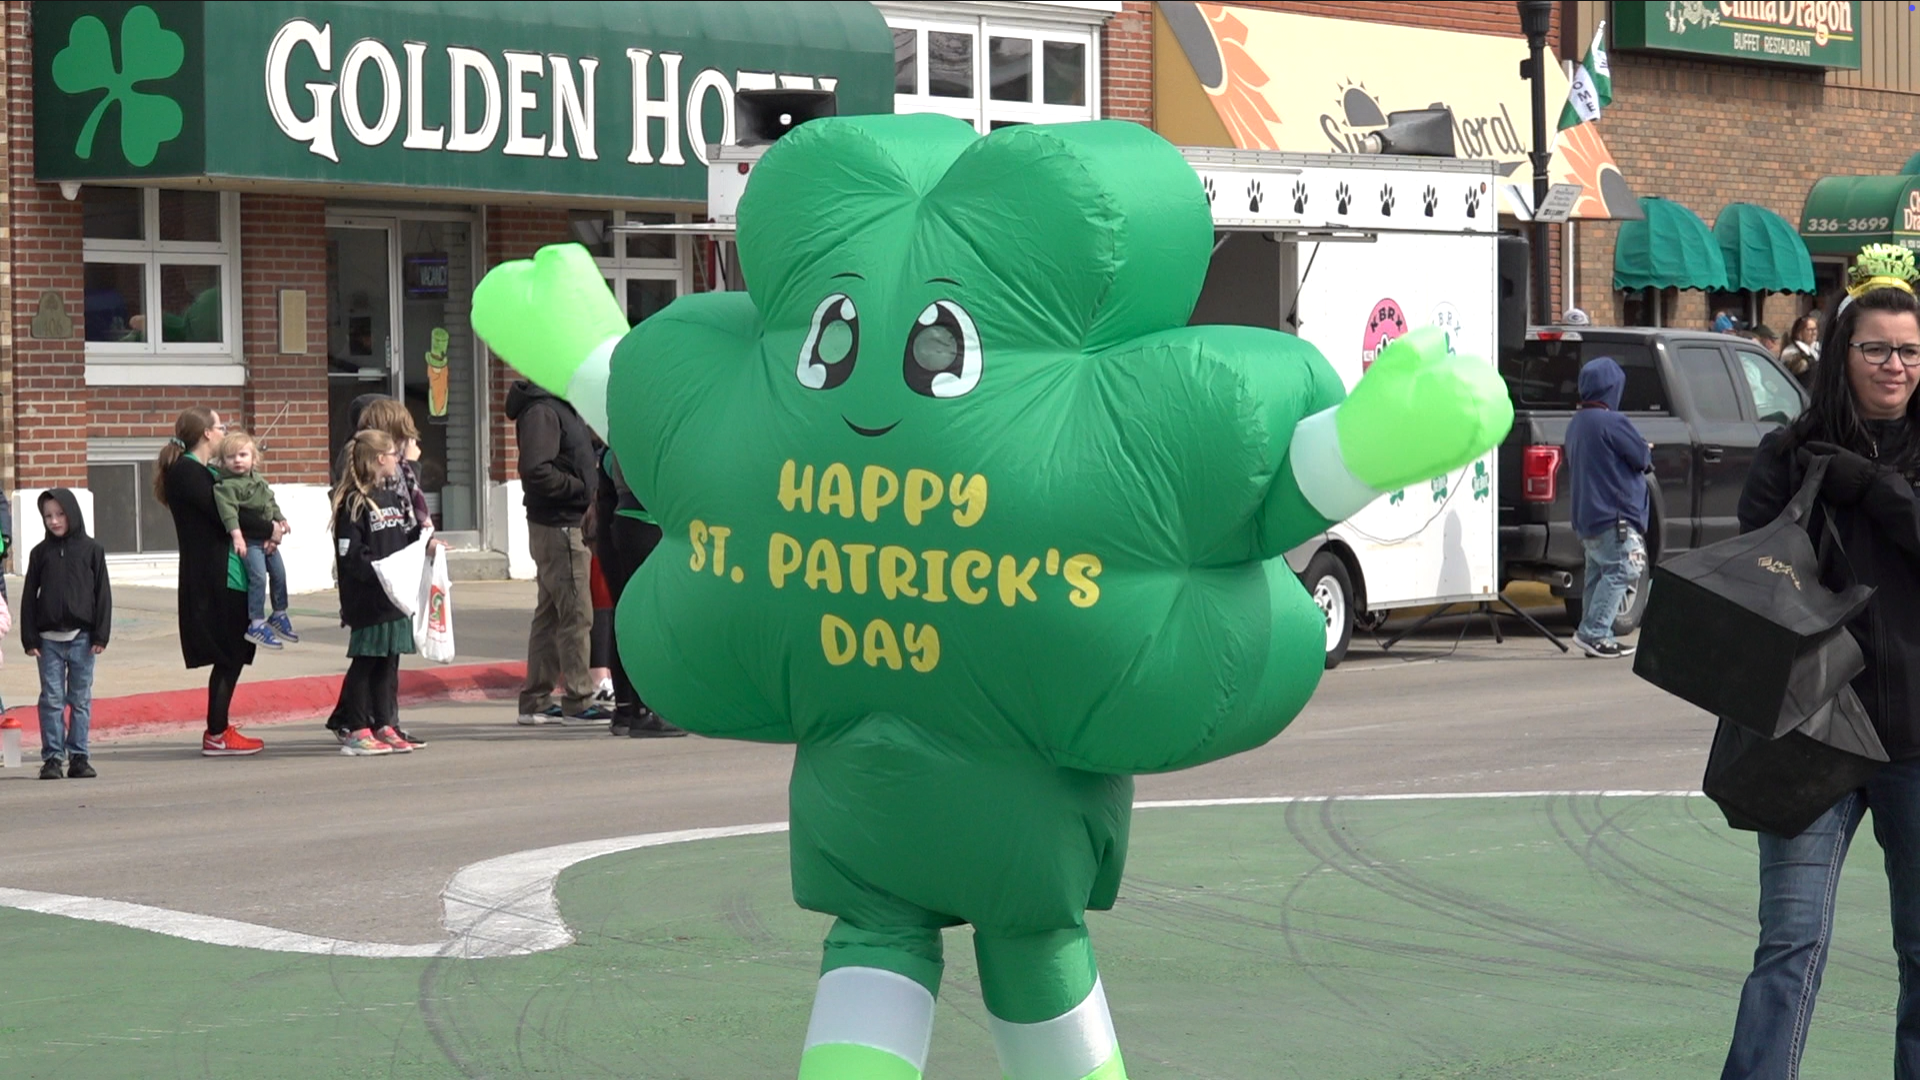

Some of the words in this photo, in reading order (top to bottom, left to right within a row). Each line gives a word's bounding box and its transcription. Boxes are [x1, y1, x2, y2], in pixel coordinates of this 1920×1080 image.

[1734, 32, 1760, 51] BUFFET
[1763, 36, 1811, 57] RESTAURANT
[1779, 1, 1853, 46] Dragon
[264, 17, 600, 163] GOLDEN
[1428, 102, 1526, 159] loral
[1807, 217, 1889, 231] 336-3699
[777, 459, 988, 527] HAPPY
[689, 520, 744, 583] ST.
[767, 532, 1102, 608] PATRICK'S
[820, 613, 940, 672] DAY
